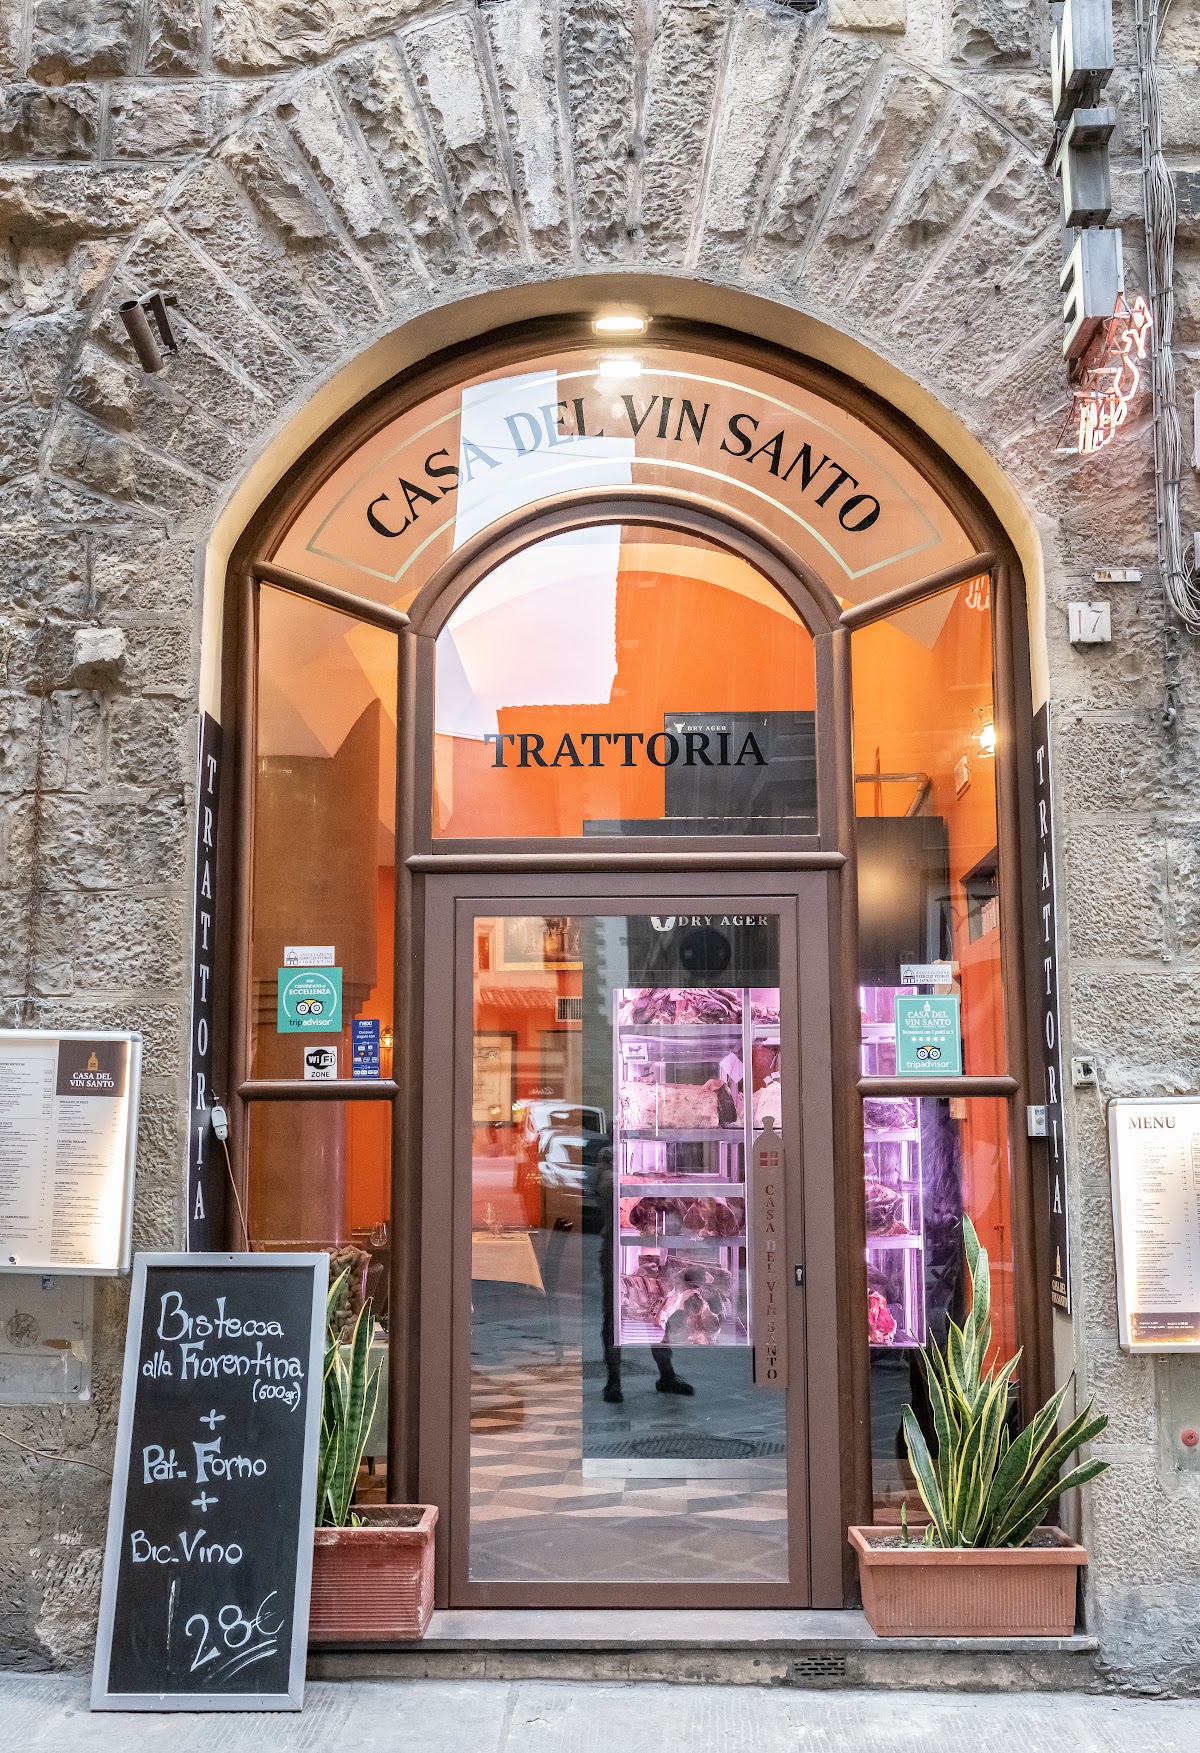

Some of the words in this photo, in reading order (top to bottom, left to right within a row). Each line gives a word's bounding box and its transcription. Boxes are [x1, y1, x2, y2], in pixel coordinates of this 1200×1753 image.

[366, 434, 503, 538] CASA
[503, 397, 604, 457] DEL
[620, 394, 710, 446] VIN
[720, 413, 881, 532] SANTO
[1078, 609, 1104, 635] 17
[484, 732, 769, 767] TRATTORIA
[678, 915, 713, 927] DRY
[720, 915, 769, 927] AGER
[194, 754, 217, 1220] TRATTORIA
[1036, 745, 1063, 1214] TRATTORIA
[289, 1018, 331, 1027] tripadvisor
[905, 1018, 922, 1026] VIN
[922, 1018, 952, 1026] SANTO
[72, 1072, 95, 1080] CASA
[96, 1072, 112, 1080] DEL
[907, 1061, 949, 1069] tripadvisor
[69, 1079, 85, 1087] VIN
[86, 1080, 115, 1088] SANTO
[1128, 1116, 1176, 1129] MENU
[765, 1184, 776, 1234] CASA
[766, 1240, 776, 1274] DEL
[156, 1291, 285, 1341] Bistecca
[765, 1281, 777, 1317] VIN
[142, 1350, 173, 1379] alla
[179, 1340, 305, 1380] Fiorentina
[766, 1321, 778, 1380] SANTO
[192, 1436, 267, 1484] Forno
